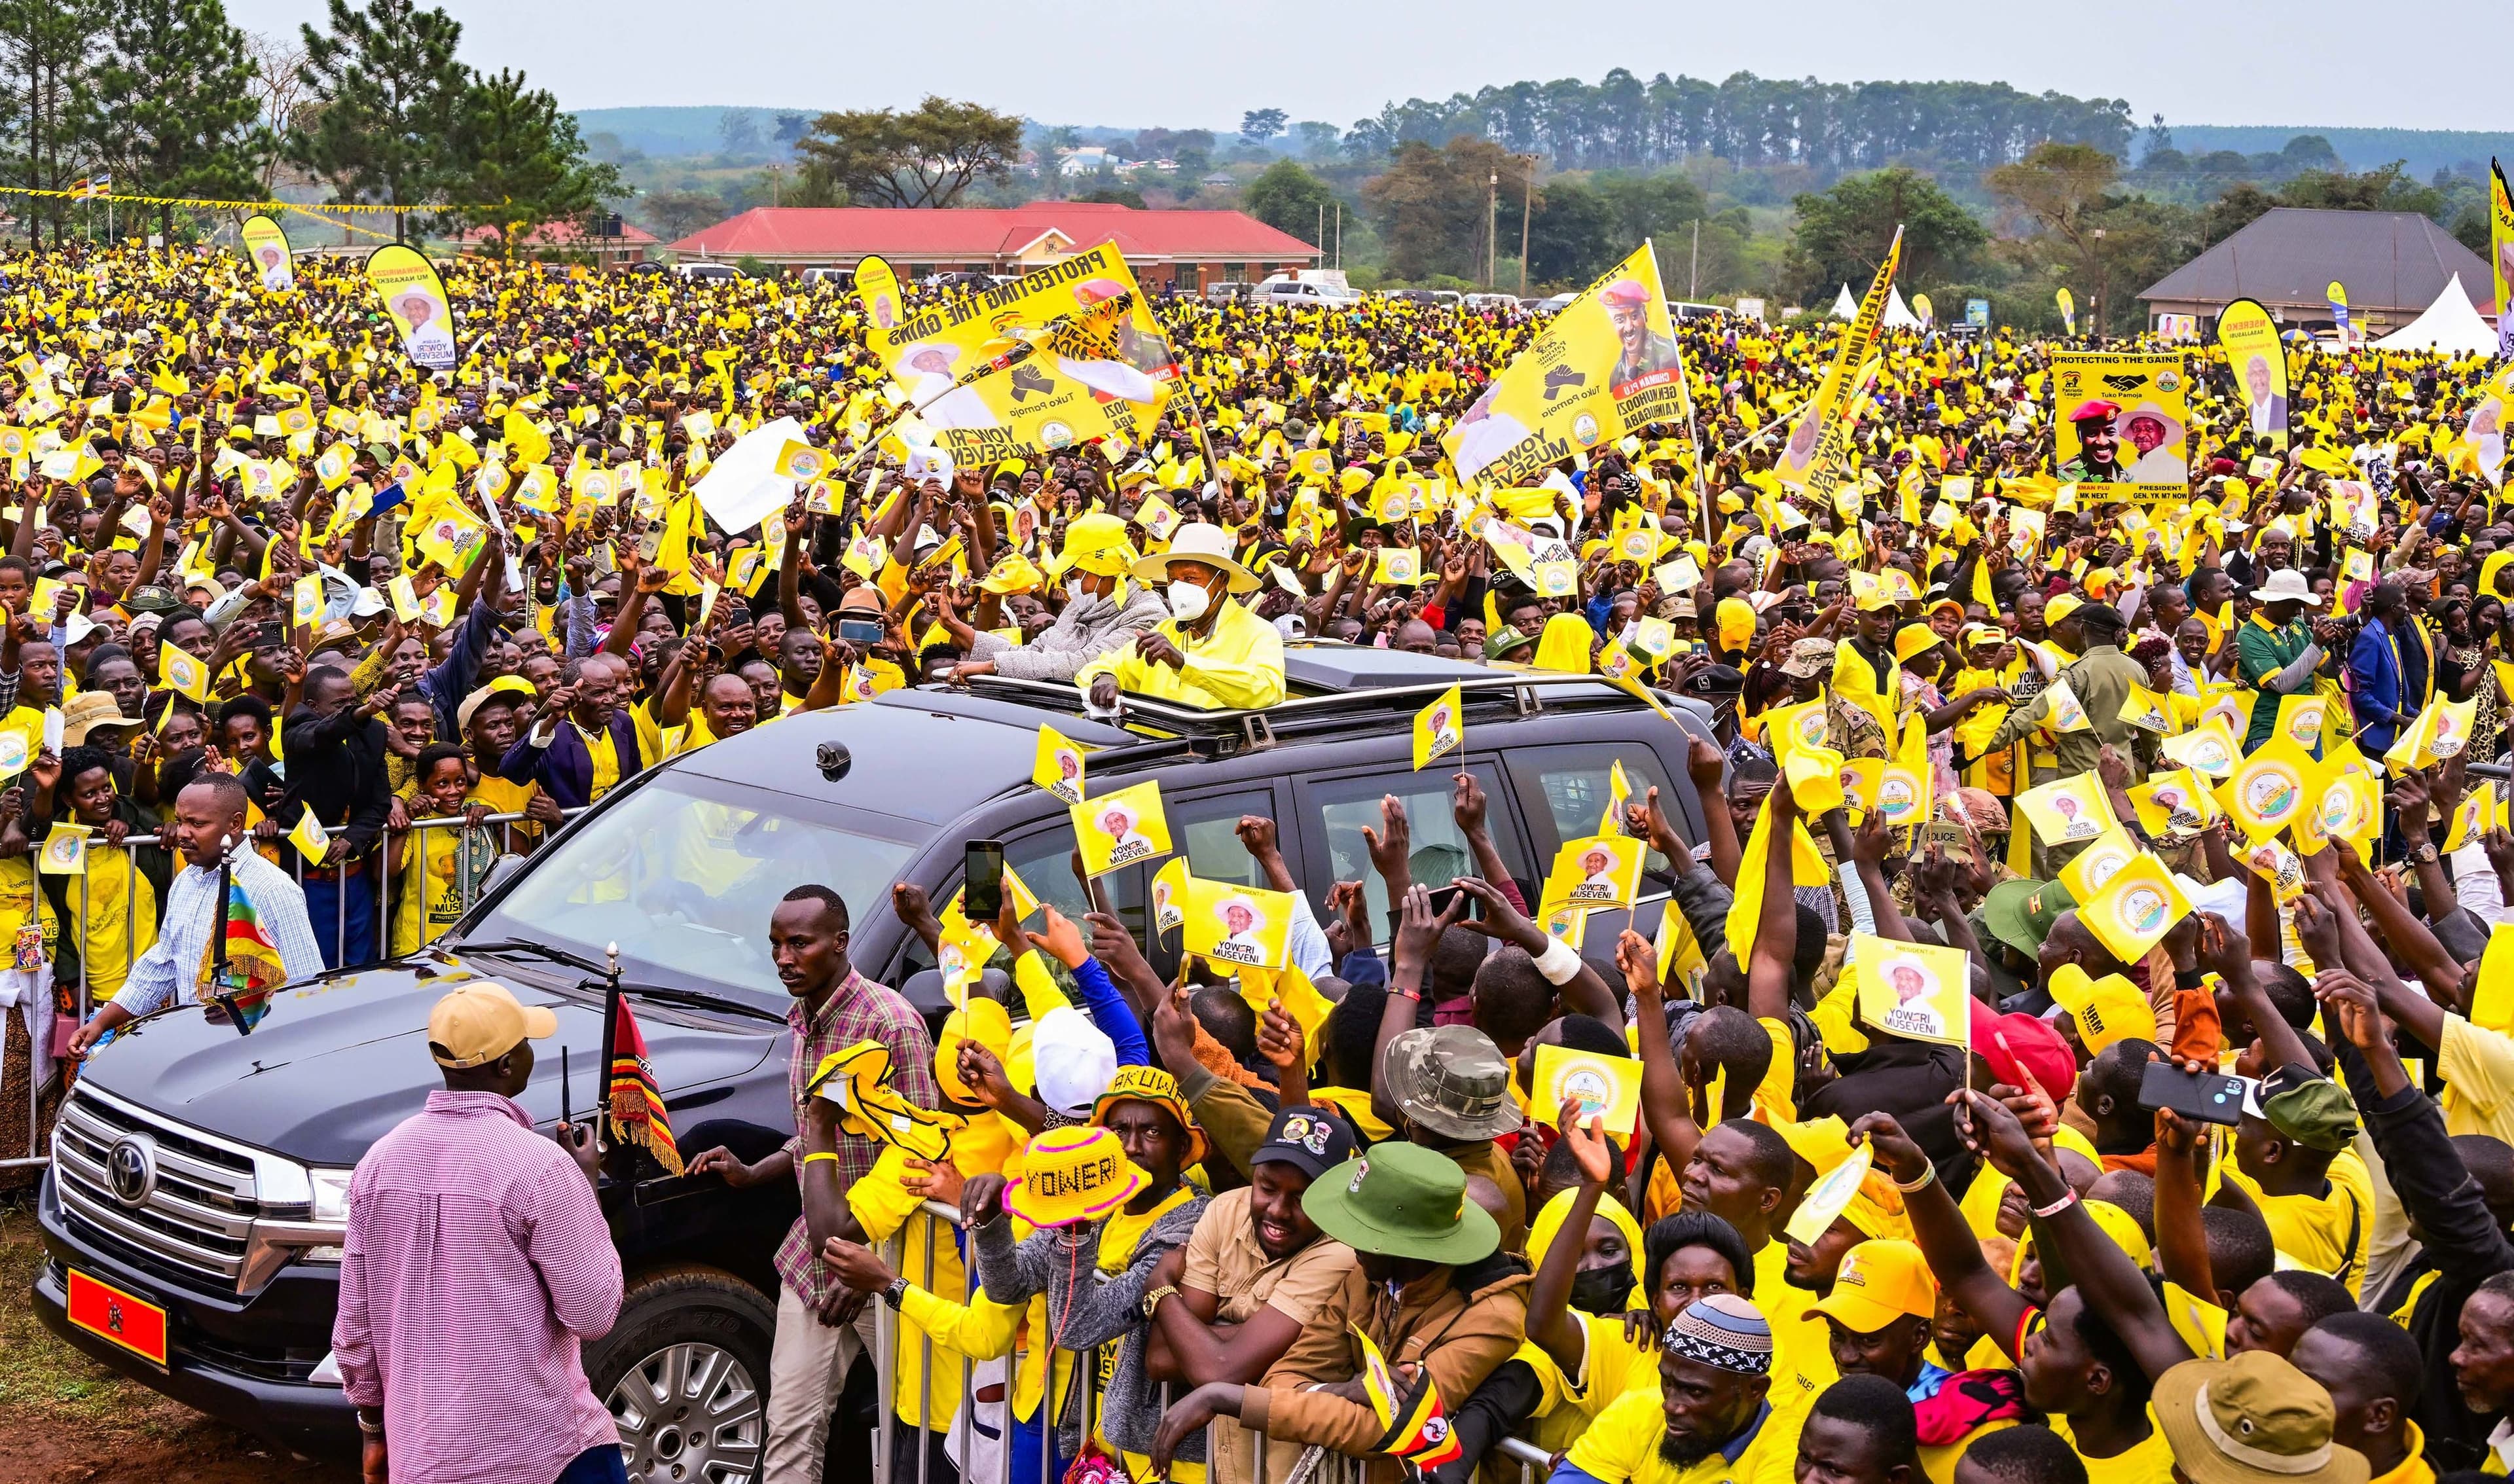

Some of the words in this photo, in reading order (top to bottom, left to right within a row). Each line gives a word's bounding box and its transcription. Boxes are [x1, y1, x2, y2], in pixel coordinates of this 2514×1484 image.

[1495, 632, 1510, 643] NRM
[2138, 716, 2168, 731] MUSEVENI
[1428, 737, 1455, 758] MUSEVENI
[1055, 779, 1078, 797] YOWERI
[1926, 832, 1956, 842] POLICE
[2065, 827, 2096, 838] MUSEVENI
[1109, 845, 1150, 865] MUSEVENI
[1110, 839, 1142, 856] YOWERI
[1231, 887, 1260, 896] PRESIDENT
[1569, 891, 1612, 899] MUSEVENI
[1218, 941, 1255, 954] YOWERI
[1895, 945, 1929, 955] PRESIDENT
[1212, 947, 1259, 964] MUSEVENI
[1889, 1008, 1930, 1023] YOWERI
[2086, 1003, 2105, 1035] NRM
[1884, 1017, 1936, 1035] MUSEVENI
[2085, 1021, 2095, 1036] PARTY
[1026, 1154, 1116, 1197] YOWERI
